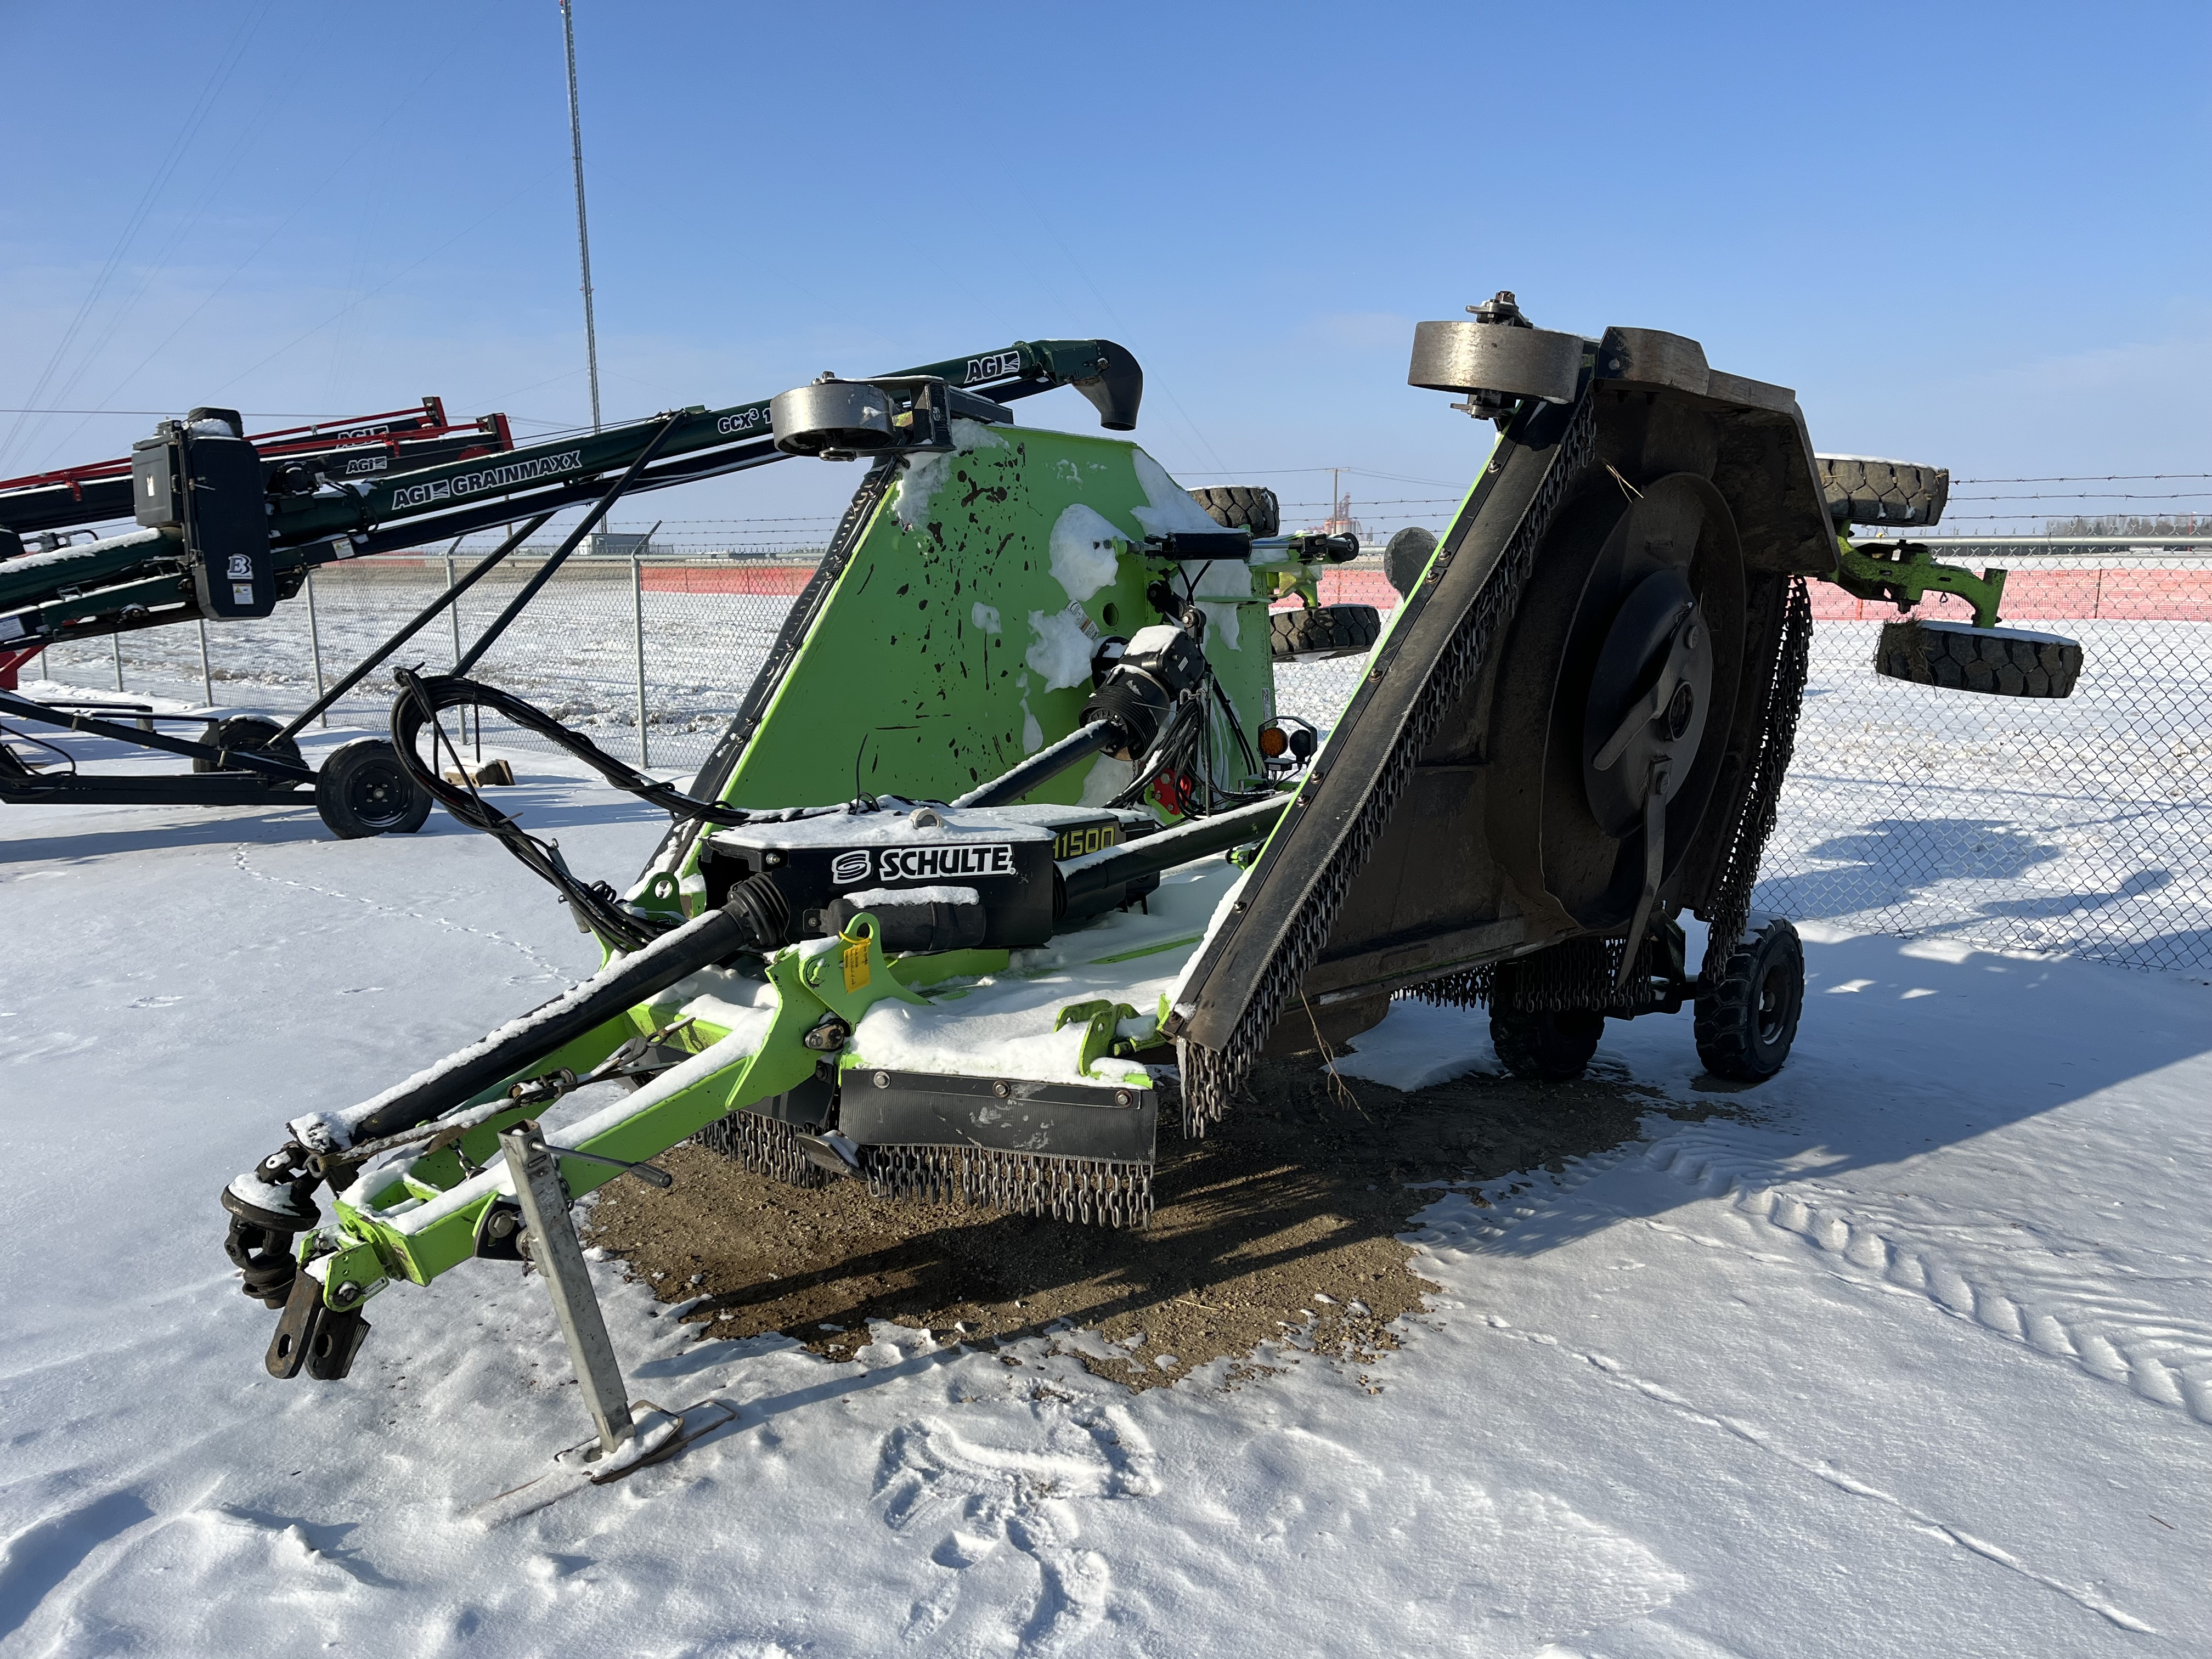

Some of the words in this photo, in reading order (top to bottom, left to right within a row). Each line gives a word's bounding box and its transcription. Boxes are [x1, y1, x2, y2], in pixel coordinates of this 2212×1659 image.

[964, 356, 1002, 383] AGI
[346, 458, 375, 474] AGI
[392, 484, 432, 510] AGI
[451, 450, 582, 496] GRAINMAXX
[879, 844, 1013, 881] SCHULTE
